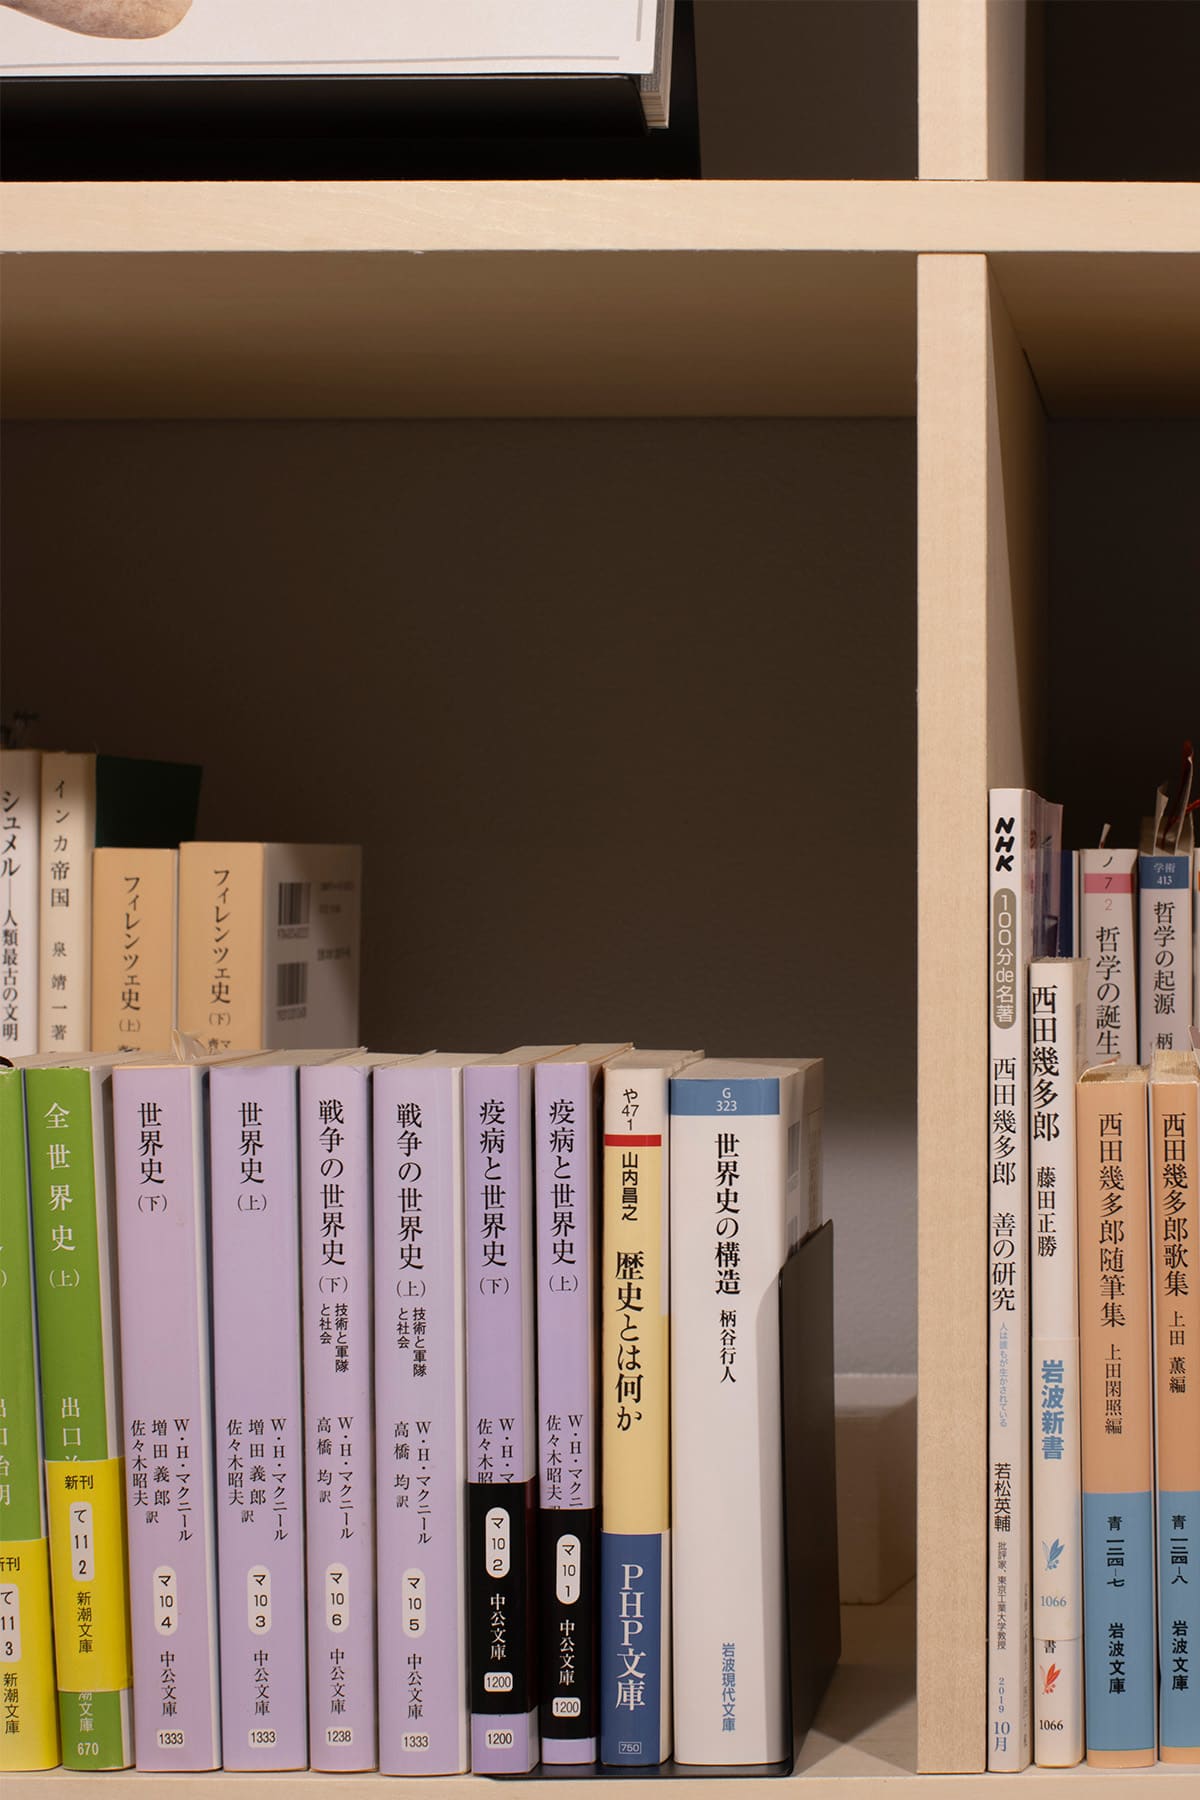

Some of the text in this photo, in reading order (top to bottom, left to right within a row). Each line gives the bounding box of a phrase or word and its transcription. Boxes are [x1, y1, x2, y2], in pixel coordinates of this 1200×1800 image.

[50, 779, 70, 908] インカ帝国
[995, 816, 1015, 872] NHK
[1103, 877, 1113, 889] 7
[1104, 899, 1113, 911] 2
[1152, 901, 1176, 1015] 哲学の起源
[1095, 926, 1122, 1056] 哲学の誕生
[621, 1088, 639, 1131] や 47 1
[715, 1087, 738, 1112] G 323
[992, 1057, 1017, 1186] 西田幾多郎
[1031, 984, 1061, 1258] 西田幾多郎 藤田正勝
[1098, 1112, 1126, 1328] 西田幾多郎随筆集
[1161, 1112, 1189, 1297] 西田幾多郎歌集
[714, 1132, 741, 1384] 世界史の構造 柄谷行人
[991, 1211, 1017, 1312] 善の研究
[319, 1303, 333, 1345] と社会
[615, 1151, 645, 1432] 山内昌之 歴史とは何か
[334, 1303, 349, 1373] 技術と軍隊
[396, 1307, 410, 1350] と社会
[412, 1306, 427, 1378] 技術と軍隊
[1040, 1359, 1065, 1461] 岩波新書
[64, 1474, 94, 1490] 新刊
[130, 1418, 149, 1507] 佐々木昭夫
[151, 1418, 171, 1507] 増田義郎
[226, 1418, 244, 1507] 佐々木昭夫
[248, 1418, 267, 1507] 増田義郎
[993, 1462, 1012, 1533] 若松英輔
[73, 1508, 89, 1575] て 11 2
[490, 1516, 506, 1572] マ 10 2
[562, 1543, 577, 1598] マ 10 1
[76, 1591, 94, 1654] 新潮文庫
[157, 1574, 174, 1629] マ 10 4
[252, 1573, 268, 1629] マ 10 3
[329, 1571, 345, 1627] マ 10 6
[407, 1576, 422, 1632] マ 10 5
[489, 1593, 507, 1661] 中公文庫
[1040, 1595, 1067, 1608] 1066
[5, 1641, 14, 1656] 3
[558, 1619, 576, 1687] 中公文庫
[614, 1563, 647, 1711] PHP文庫
[1107, 1622, 1126, 1694] 岩波文庫
[1171, 1619, 1189, 1692] 岩波文庫
[2, 1672, 20, 1735] 新潮文庫
[159, 1650, 178, 1717] 中公文庫
[253, 1649, 271, 1716] 中公文庫
[329, 1648, 347, 1715] 中公文庫
[407, 1653, 424, 1720] 中公文庫
[486, 1675, 511, 1689] 1200
[554, 1700, 579, 1714] 1200
[721, 1642, 736, 1733] 岩波現代文庫
[998, 1676, 1006, 1715] 2019
[77, 1741, 99, 1757] 670
[158, 1732, 184, 1746] 1333
[250, 1731, 276, 1744] 1333
[326, 1730, 352, 1743] 1238
[403, 1734, 429, 1748] 1333
[487, 1732, 513, 1746] 1200
[620, 1743, 640, 1753] 750
[1039, 1719, 1064, 1731] 1066
